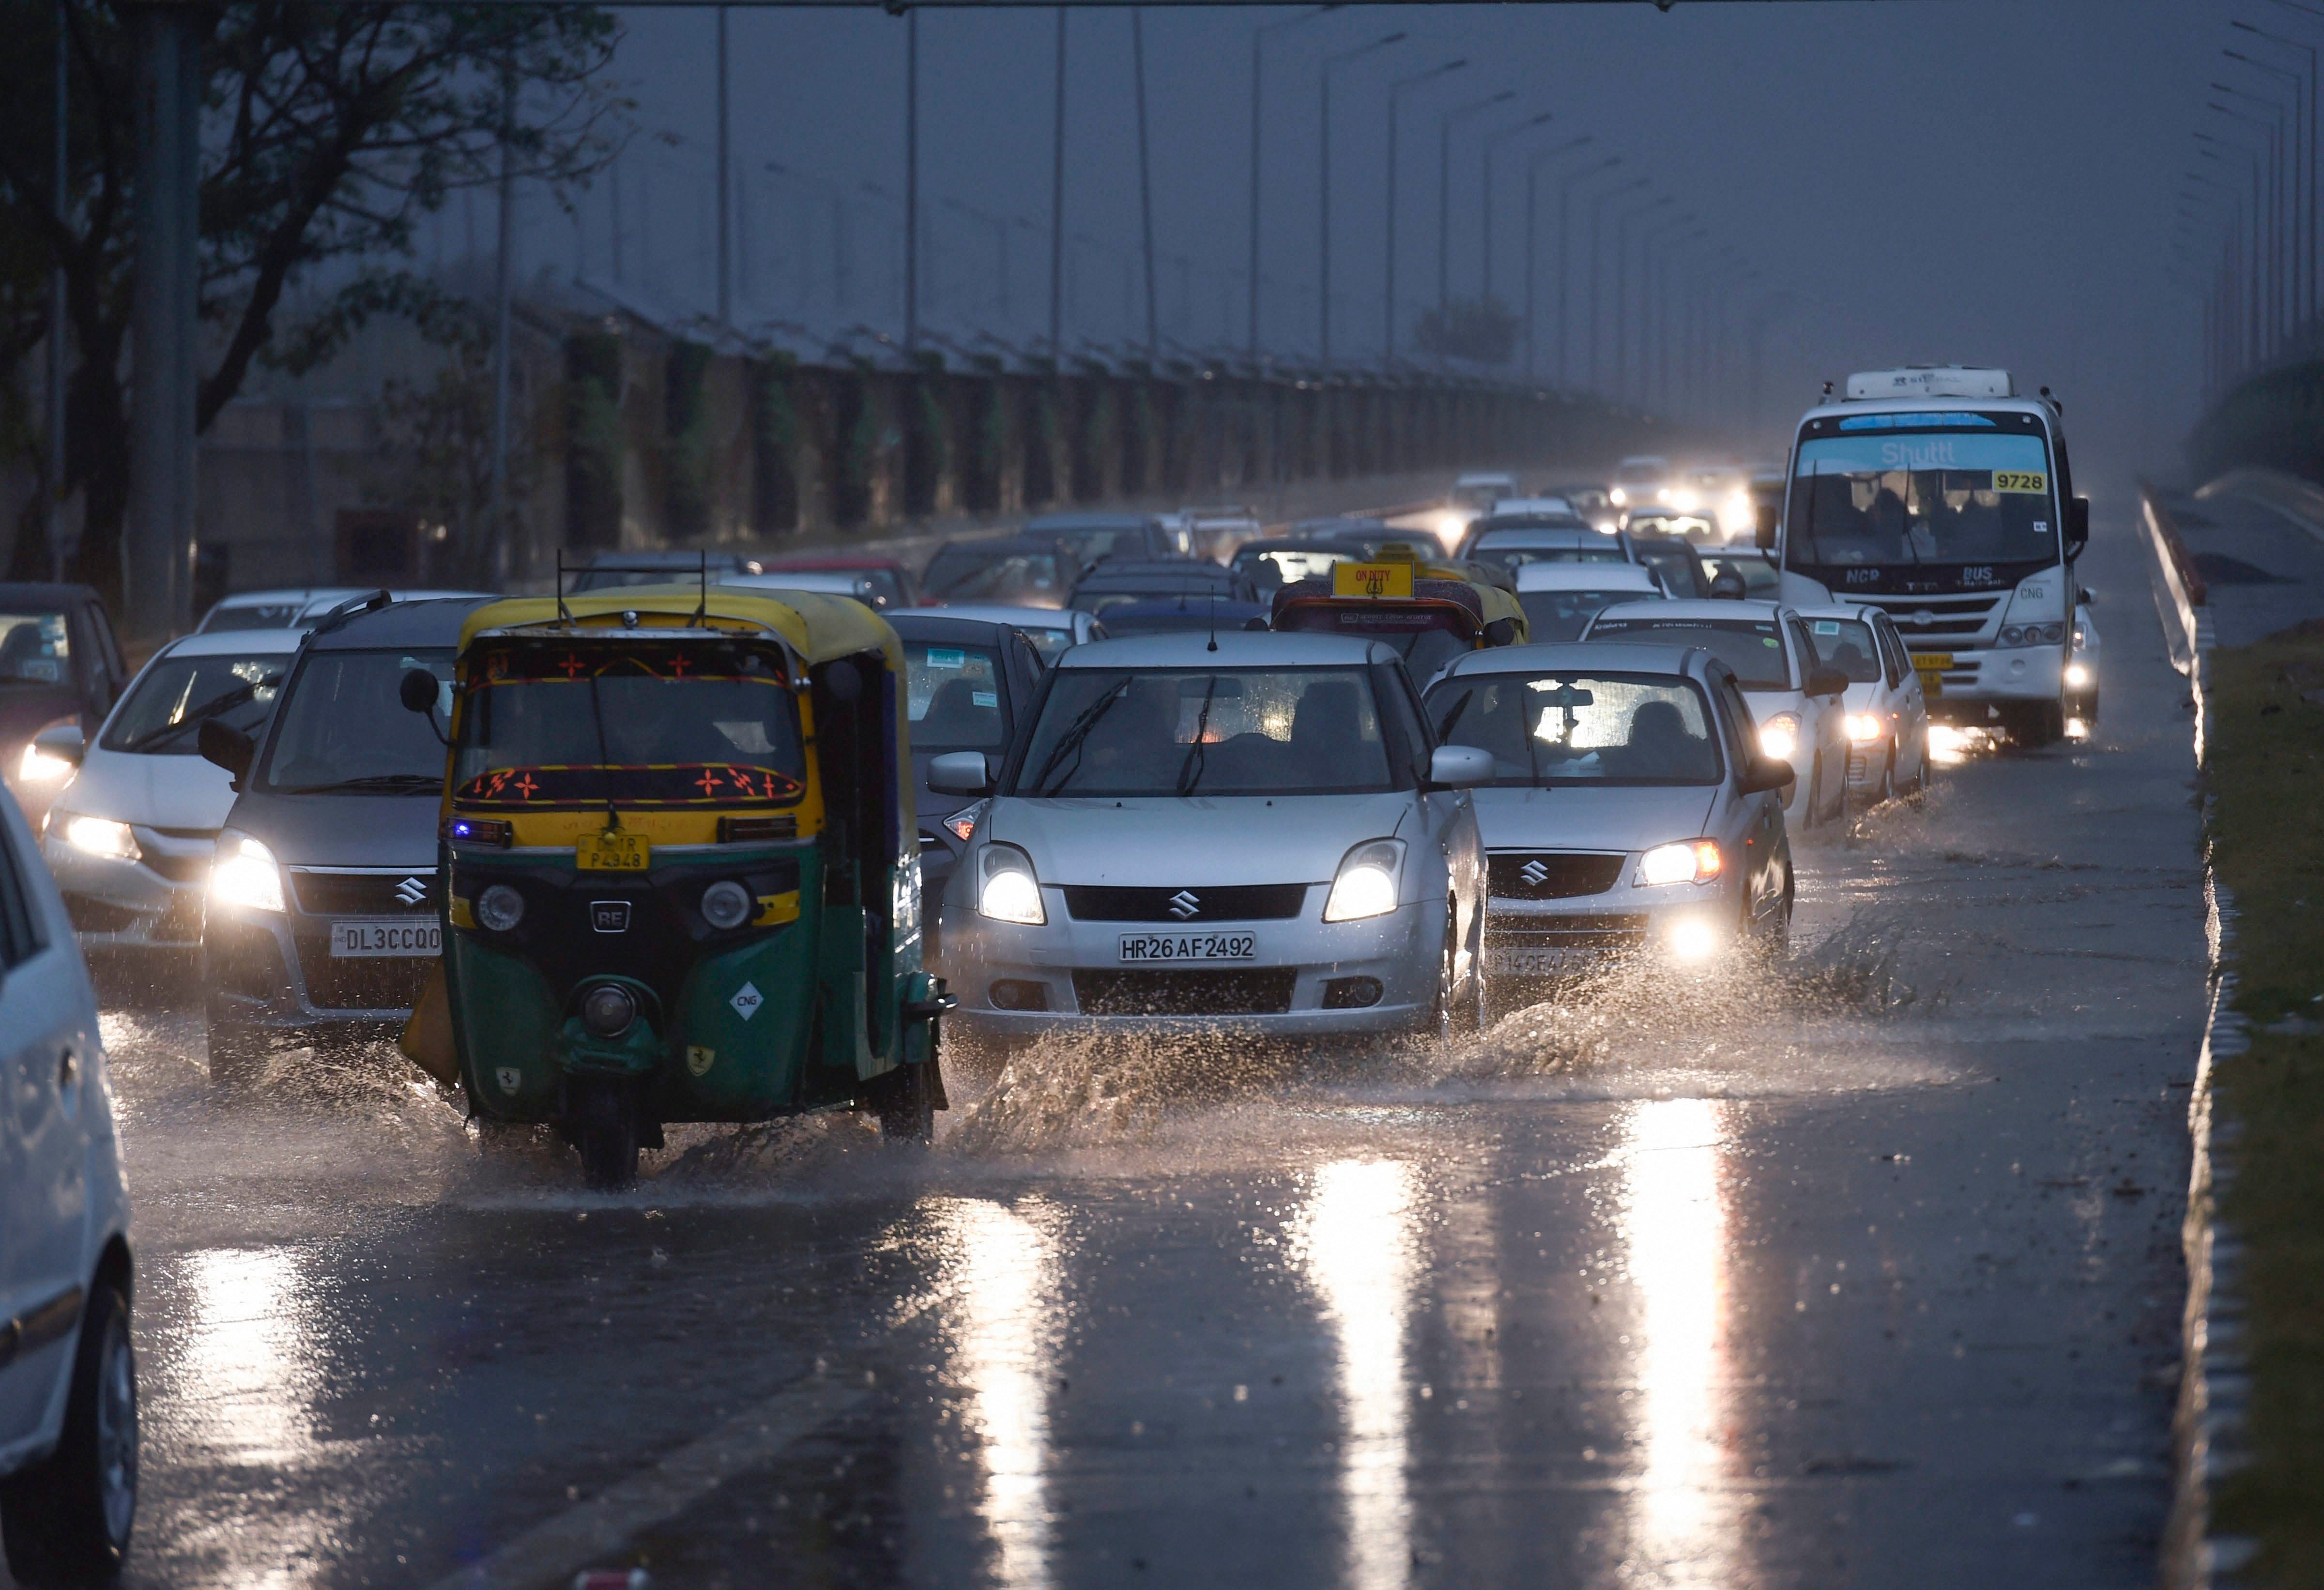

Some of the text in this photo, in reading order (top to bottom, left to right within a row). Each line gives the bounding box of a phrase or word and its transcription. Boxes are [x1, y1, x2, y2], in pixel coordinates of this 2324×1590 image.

[1881, 441, 1956, 465] Shuttl
[1997, 474, 2043, 490] 9728
[1356, 570, 1391, 582] ON DUTY
[1846, 568, 1881, 584] NCR
[1963, 566, 1993, 581] BUS
[2020, 587, 2044, 599] CNG
[591, 852, 641, 867] P4948
[597, 911, 623, 926] RE
[737, 995, 757, 1006] CNG
